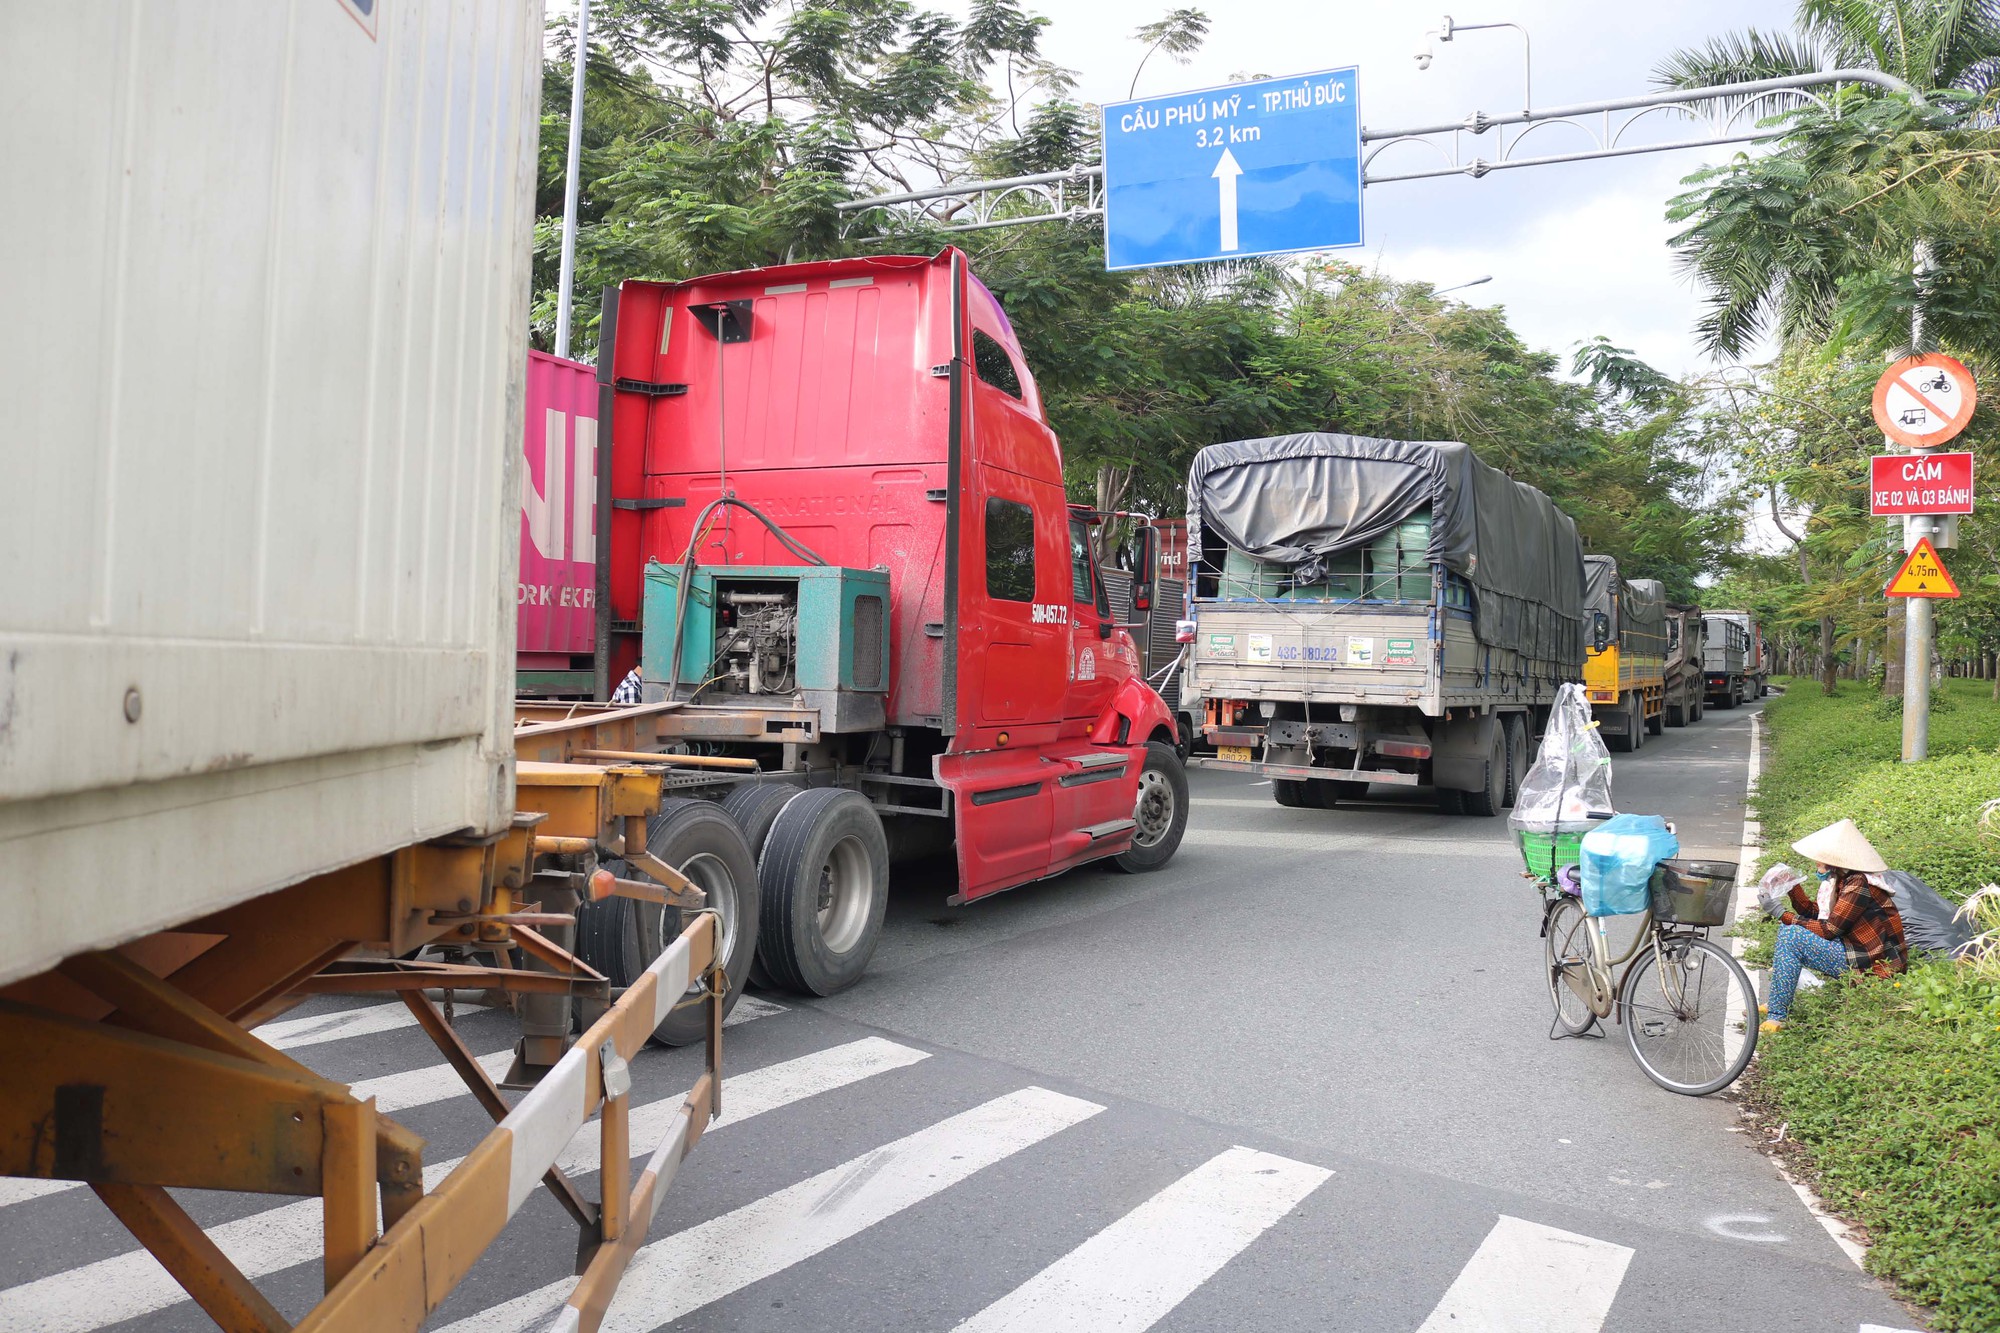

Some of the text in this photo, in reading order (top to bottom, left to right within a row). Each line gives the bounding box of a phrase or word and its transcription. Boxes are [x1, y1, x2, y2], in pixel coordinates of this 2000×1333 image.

[1121, 105, 1159, 133] CẦU
[1165, 98, 1206, 127] PHÚ
[1212, 94, 1241, 120] MỸ
[1262, 80, 1312, 113] TP.THỦ
[1315, 77, 1346, 105] ĐỨC
[1230, 124, 1261, 144] km
[1902, 456, 1942, 481] CẤM
[1875, 485, 1969, 506] XE 02 VÀ 03 BÁNH
[1277, 646, 1337, 661] 43C-080.22
